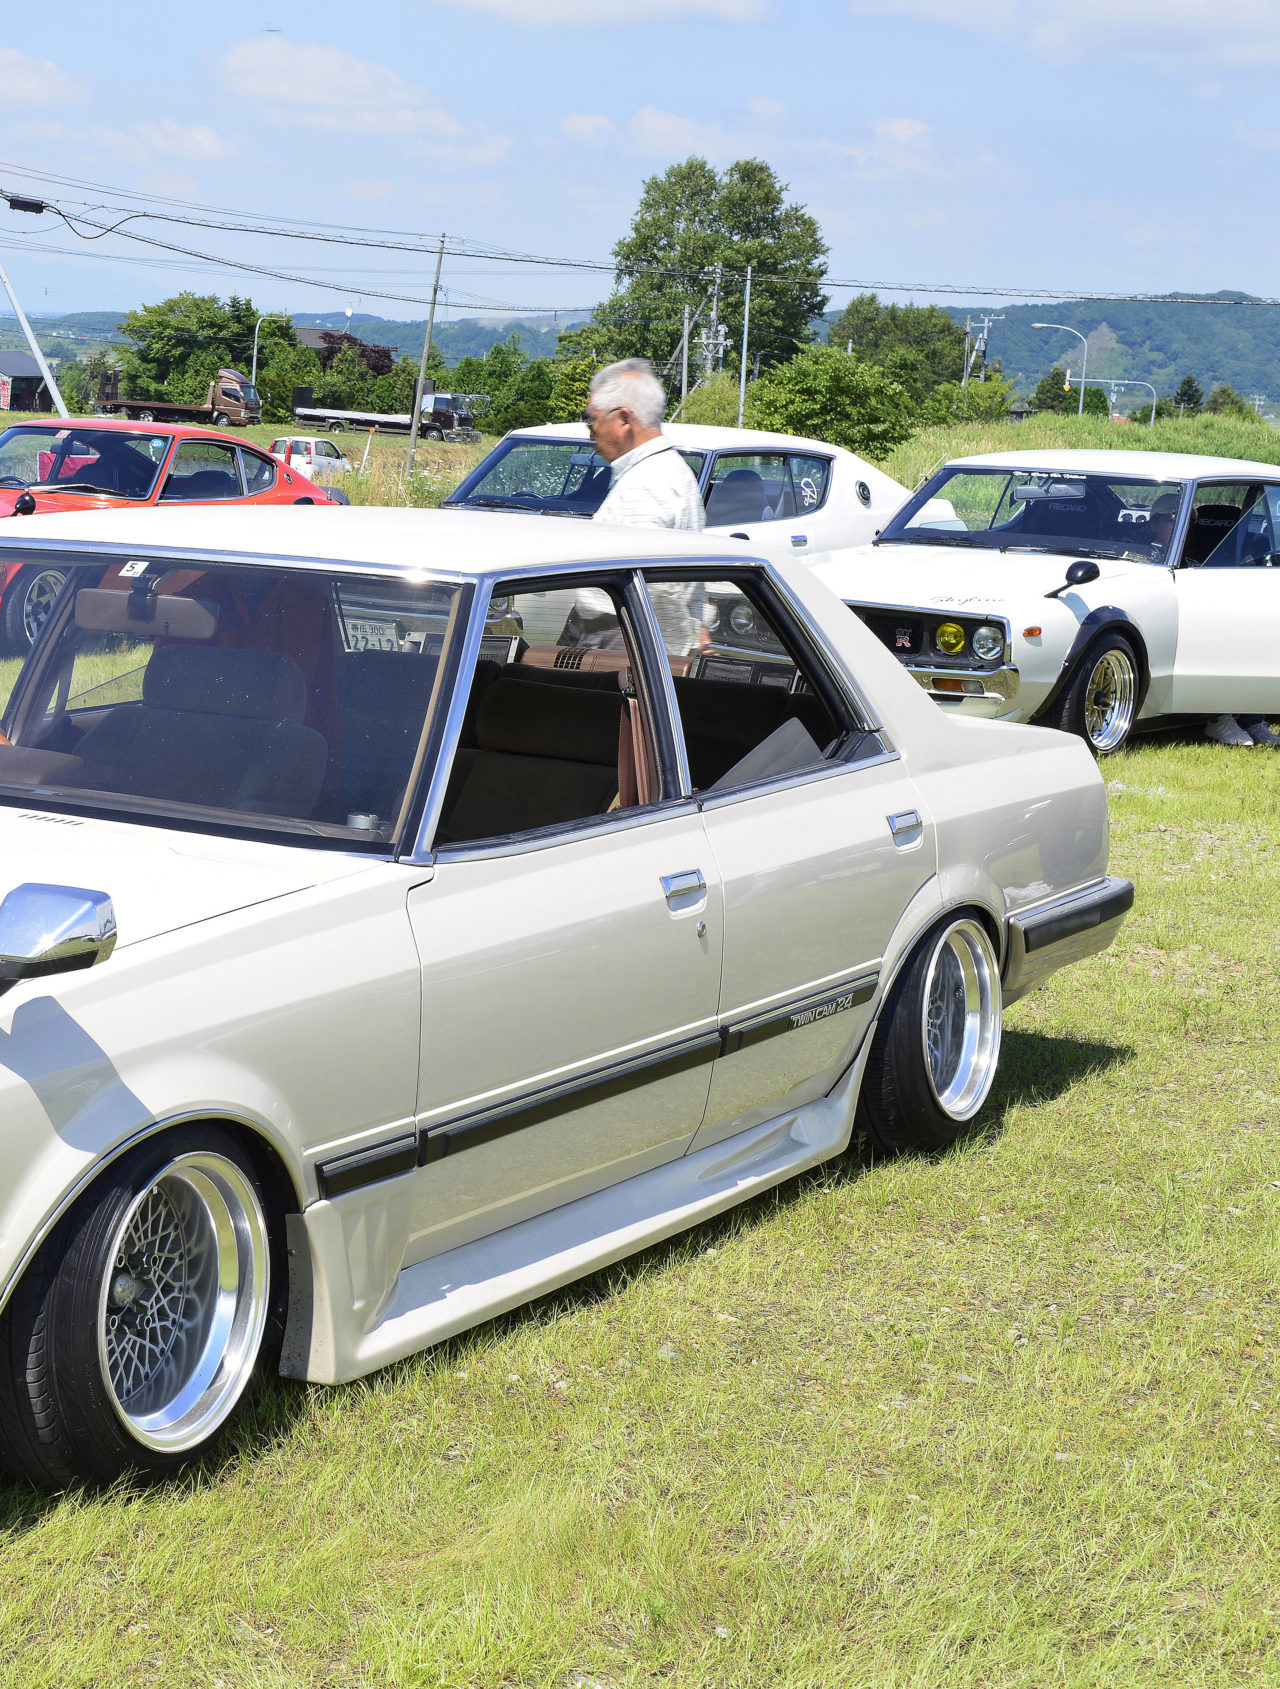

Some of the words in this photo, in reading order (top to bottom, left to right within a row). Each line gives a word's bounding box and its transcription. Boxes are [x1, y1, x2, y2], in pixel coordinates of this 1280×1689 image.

[126, 562, 138, 572] 5
[369, 624, 385, 636] 300
[895, 636, 911, 647] R
[790, 1010, 815, 1028] TWIN
[816, 1002, 837, 1019] CAM
[836, 992, 854, 1012] 24
